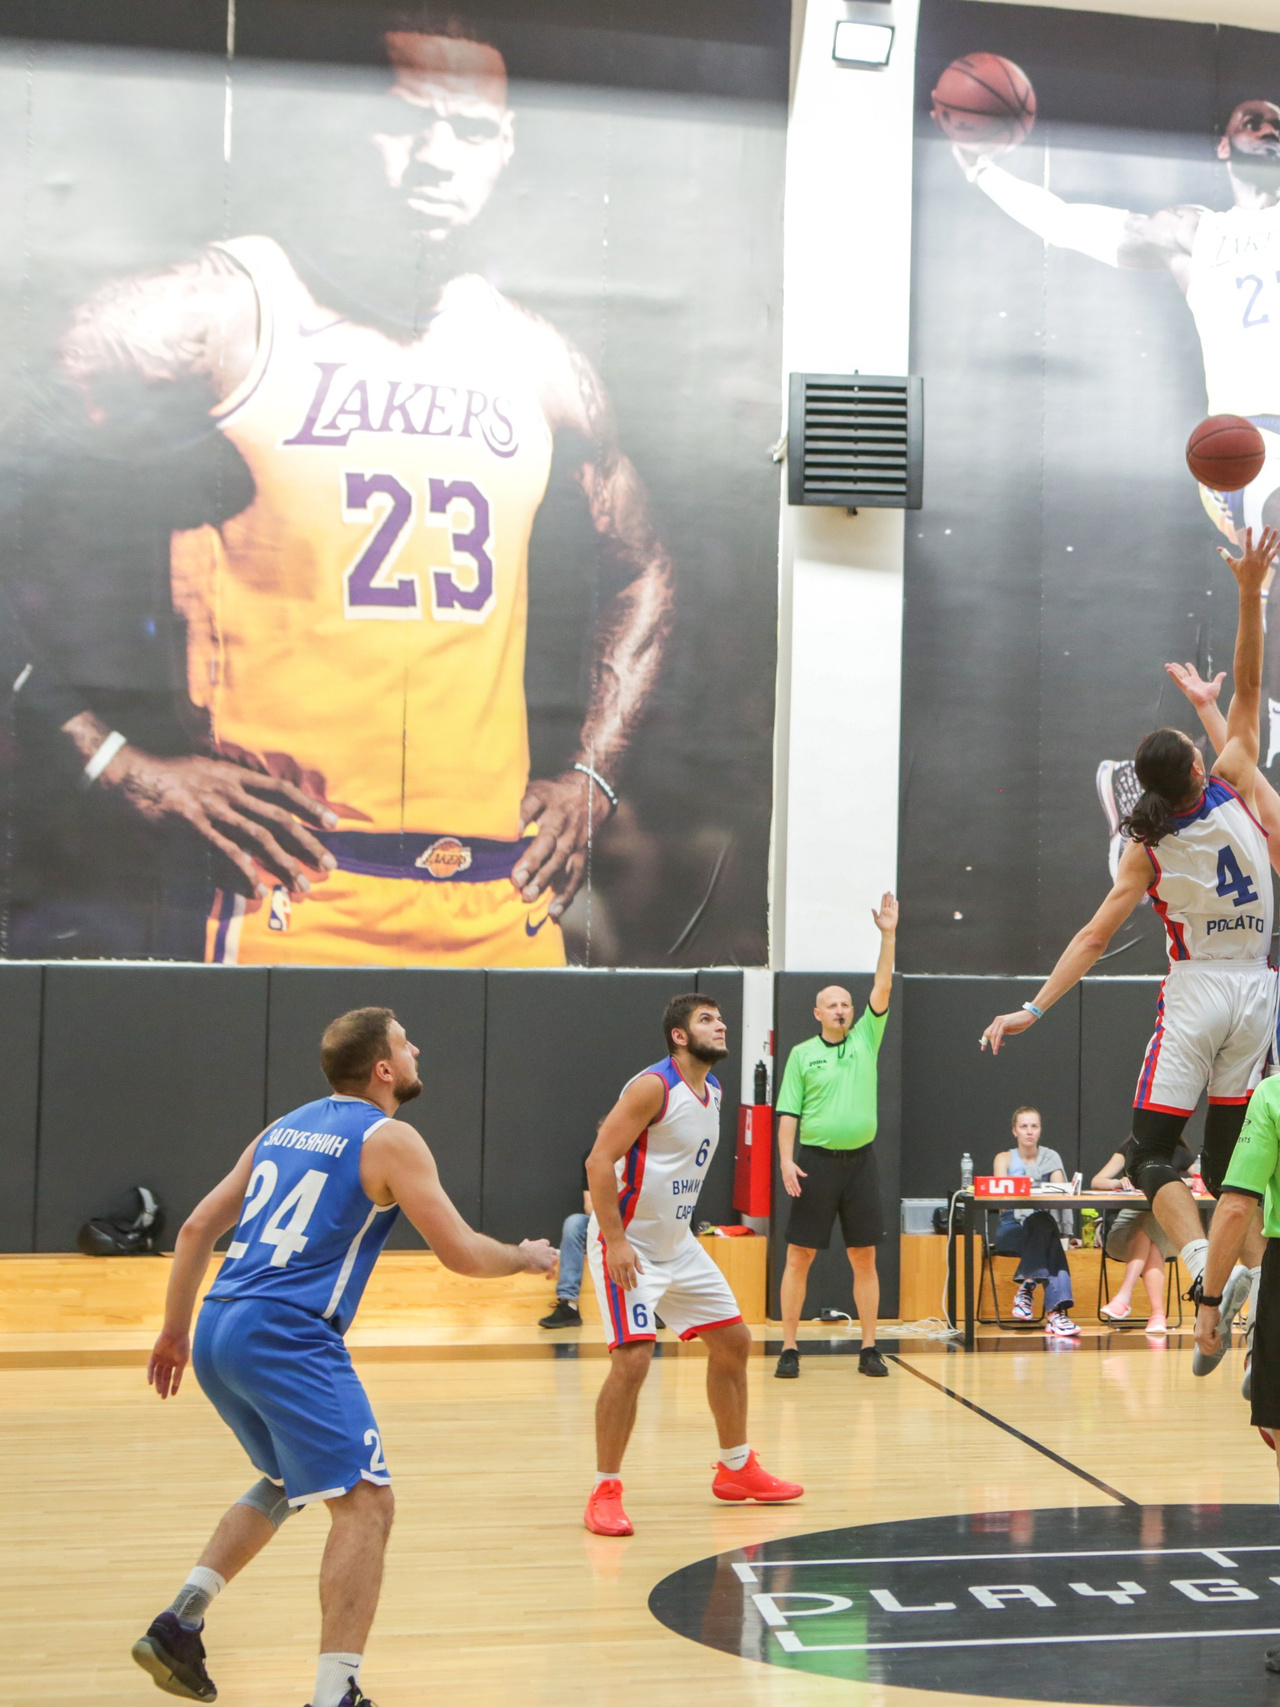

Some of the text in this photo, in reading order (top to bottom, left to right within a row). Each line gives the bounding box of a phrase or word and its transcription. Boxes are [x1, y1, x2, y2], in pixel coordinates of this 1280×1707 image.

[281, 361, 520, 459] LAKERS
[342, 470, 496, 622] 23
[1215, 844, 1259, 908] 4
[263, 1127, 349, 1159] ЗАЛУБЯНИН
[695, 1138, 710, 1168] 6
[225, 1159, 329, 1268] 24
[632, 1302, 649, 1328] 6
[363, 1428, 386, 1473] 2
